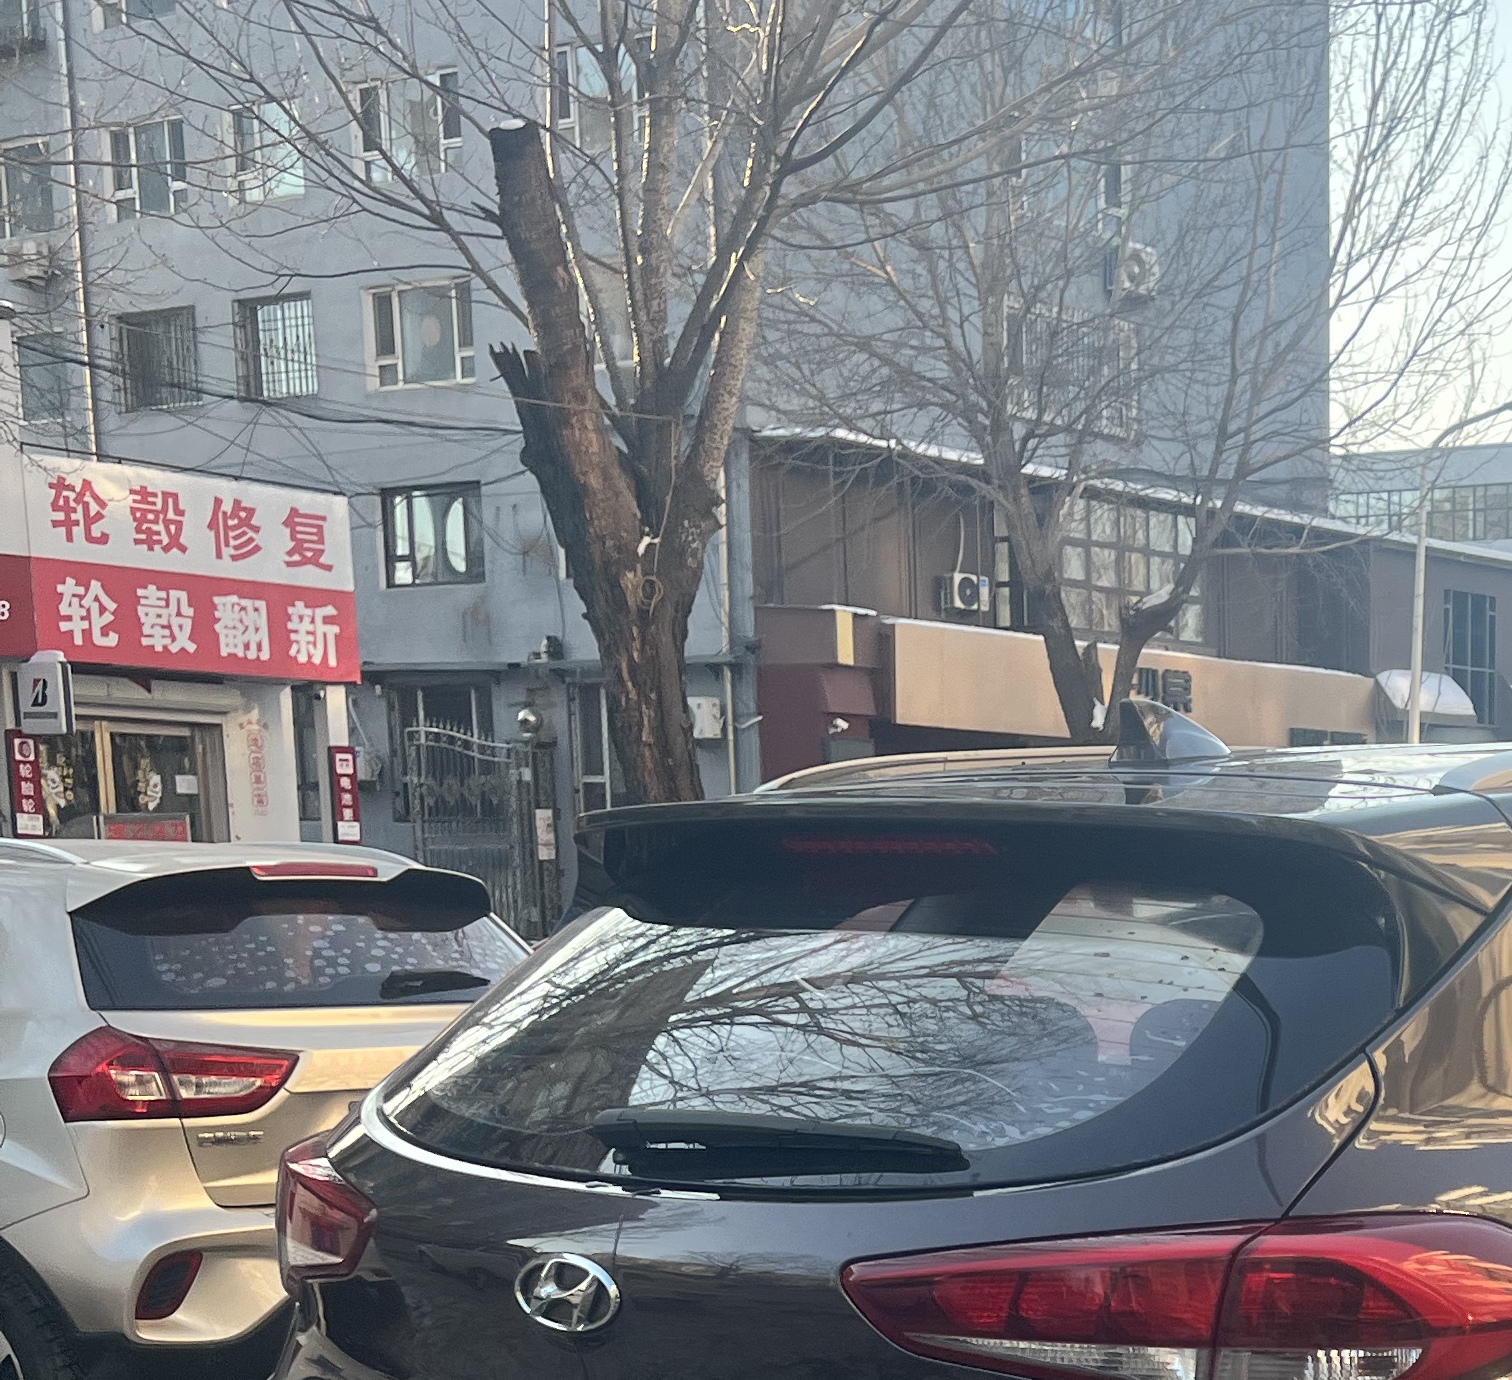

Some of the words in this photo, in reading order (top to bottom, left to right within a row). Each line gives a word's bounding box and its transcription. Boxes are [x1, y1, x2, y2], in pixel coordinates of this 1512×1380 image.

[48, 476, 334, 573] 轮毂修复
[56, 576, 341, 668] 轮毂翻新
